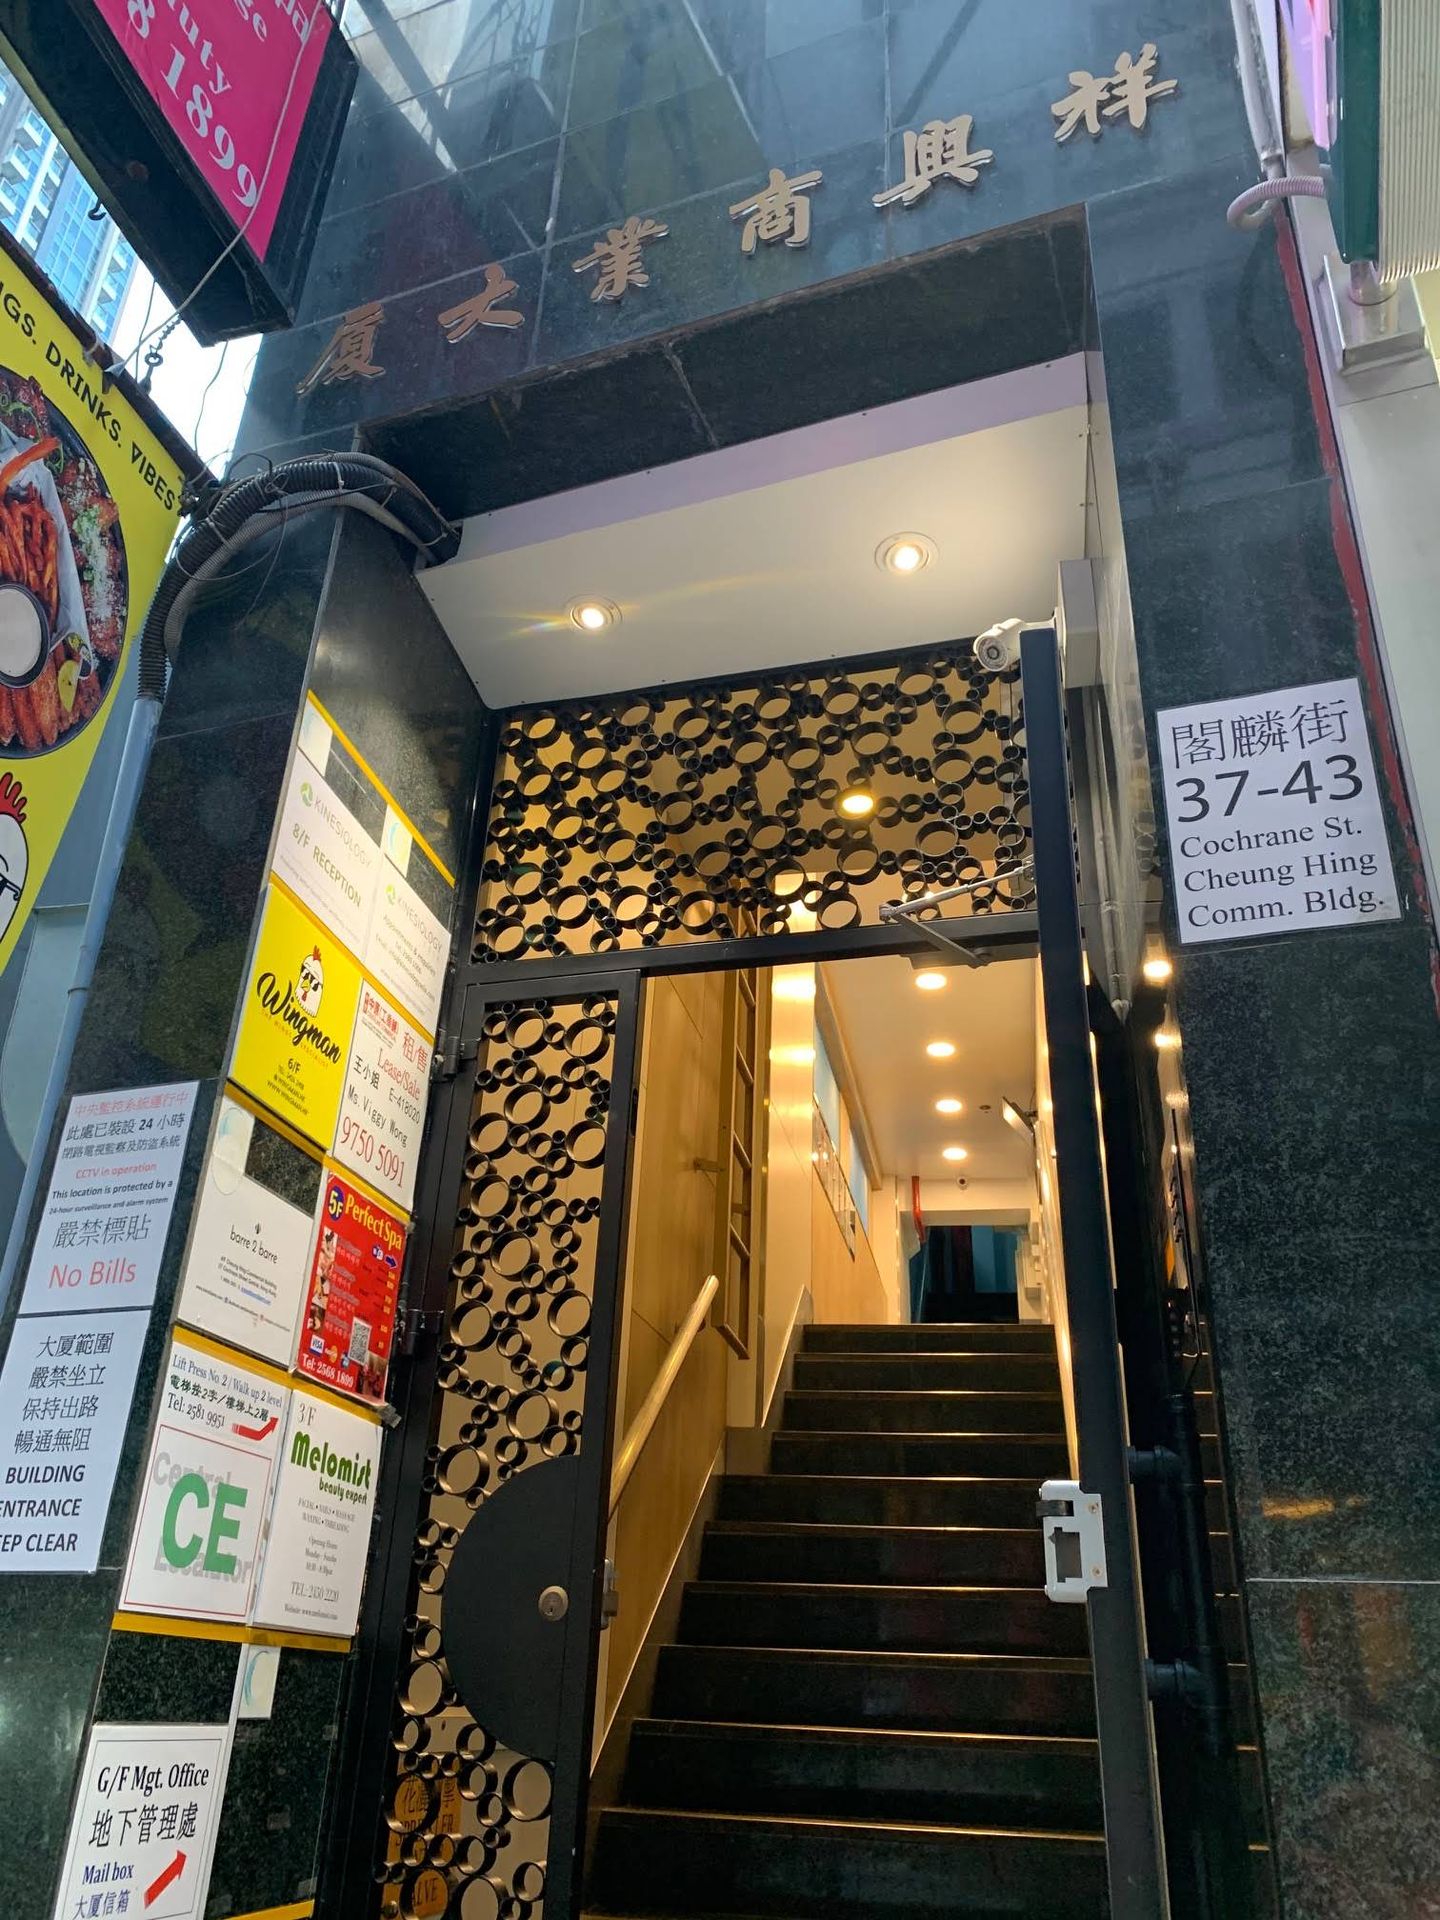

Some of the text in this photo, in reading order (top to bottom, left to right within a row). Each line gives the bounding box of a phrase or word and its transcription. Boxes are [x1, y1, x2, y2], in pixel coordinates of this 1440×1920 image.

[160, 43, 258, 207] 1899
[0, 281, 36, 345] GS.
[45, 341, 122, 448] DRINKS.
[1171, 699, 1349, 769] 閣麟街
[1175, 754, 1364, 823] 37-43
[1180, 816, 1362, 858] Cochrane St.
[292, 823, 311, 848] 8/F
[313, 845, 362, 908] RECEPTION
[1184, 851, 1378, 892] Cheung Hing
[1188, 886, 1384, 927] Comm. Bldg.
[257, 972, 341, 1064] Wingman
[287, 1058, 301, 1074] 6/F
[354, 1054, 381, 1090] 王小姐
[377, 1048, 421, 1101] Lease/Sale
[138, 1117, 153, 1131] 24
[157, 1112, 185, 1131] 小時
[389, 1121, 408, 1148] Wong
[340, 1116, 405, 1188] 9750 5091
[75, 1162, 158, 1180] CCTV in operation
[52, 1179, 173, 1200] This location is protected by a
[112, 1200, 125, 1208] and
[126, 1198, 145, 1208] alarm
[327, 1189, 344, 1220] 5F
[52, 1213, 152, 1249] 嚴禁標貼
[230, 1225, 278, 1265] barre 2 barre
[48, 1257, 137, 1290] No Bills
[36, 1331, 114, 1359] 大廈範圍
[28, 1363, 106, 1390] 嚴禁坐立
[172, 1354, 187, 1372] Lift
[188, 1361, 207, 1379] Press
[221, 1374, 228, 1387] 2
[233, 1377, 249, 1396] Walk
[250, 1388, 260, 1404] up
[266, 1390, 282, 1408] level
[302, 1355, 316, 1374] Tel:
[22, 1395, 100, 1422] 保持出路
[168, 1391, 226, 1429] Tel: 2581 9951
[14, 1427, 91, 1454] 暢通無阻
[5, 1464, 86, 1485] BUILDING
[290, 1430, 372, 1490] Melomist
[319, 1476, 368, 1505] beauty expert
[162, 1472, 248, 1576] CE
[26, 1533, 78, 1552] CLEAR
[97, 1763, 209, 1799] G/F Mgt. Office
[89, 1801, 199, 1849] 地下管理處
[82, 1861, 134, 1885] Mail box
[72, 1889, 131, 1920] 大廈信箱
